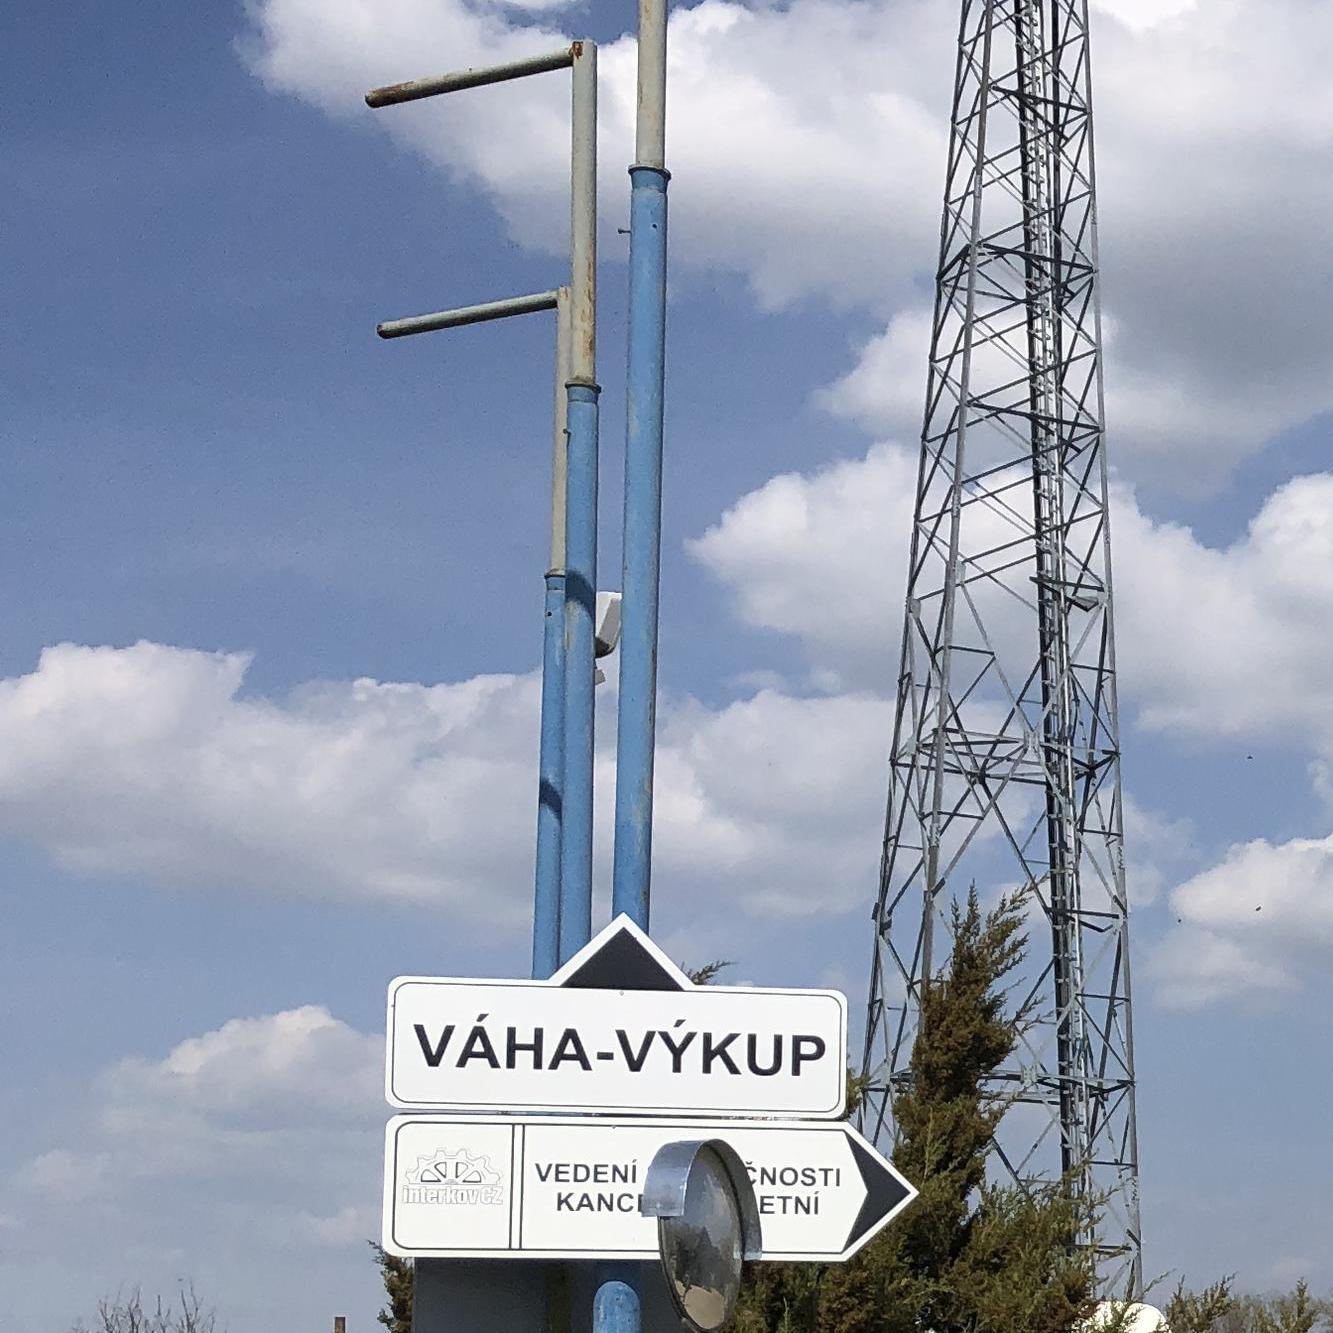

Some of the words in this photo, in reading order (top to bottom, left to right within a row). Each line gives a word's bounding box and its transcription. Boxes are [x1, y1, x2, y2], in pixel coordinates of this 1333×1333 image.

[413, 1013, 826, 1077] VÁHA-VÝKUP
[535, 1159, 637, 1184] VEDENÍ
[402, 1185, 479, 1205] interkov
[480, 1186, 504, 1205] CZ
